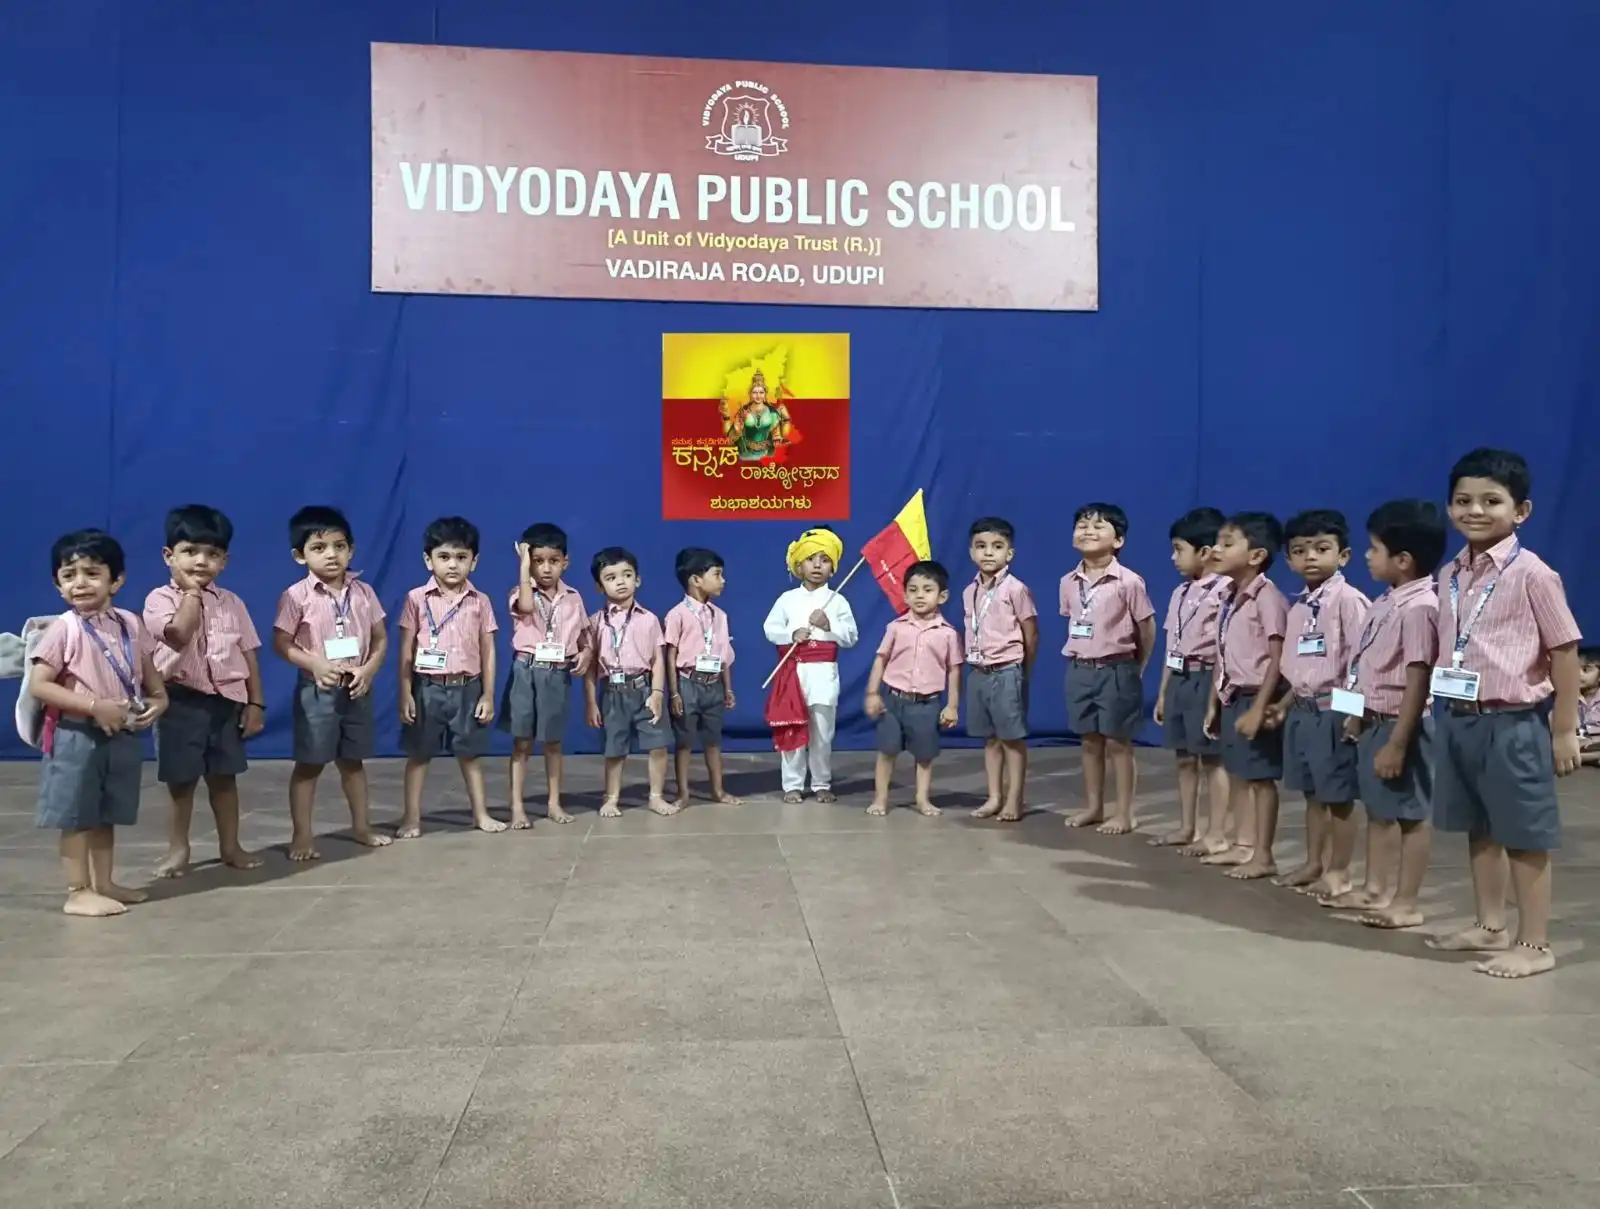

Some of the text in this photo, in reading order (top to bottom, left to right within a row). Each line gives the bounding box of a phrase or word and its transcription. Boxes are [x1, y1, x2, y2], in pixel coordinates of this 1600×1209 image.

[702, 80, 789, 130] VIDYODAYA PUBLIC SCHOOL
[399, 161, 1076, 232] VIDYODAYA PUBLIC SCHOOL
[608, 228, 882, 256] [A Unit of Vidyodaya Trust (R.)]
[605, 258, 884, 287] VADIRAJA ROAD, UDUPI
